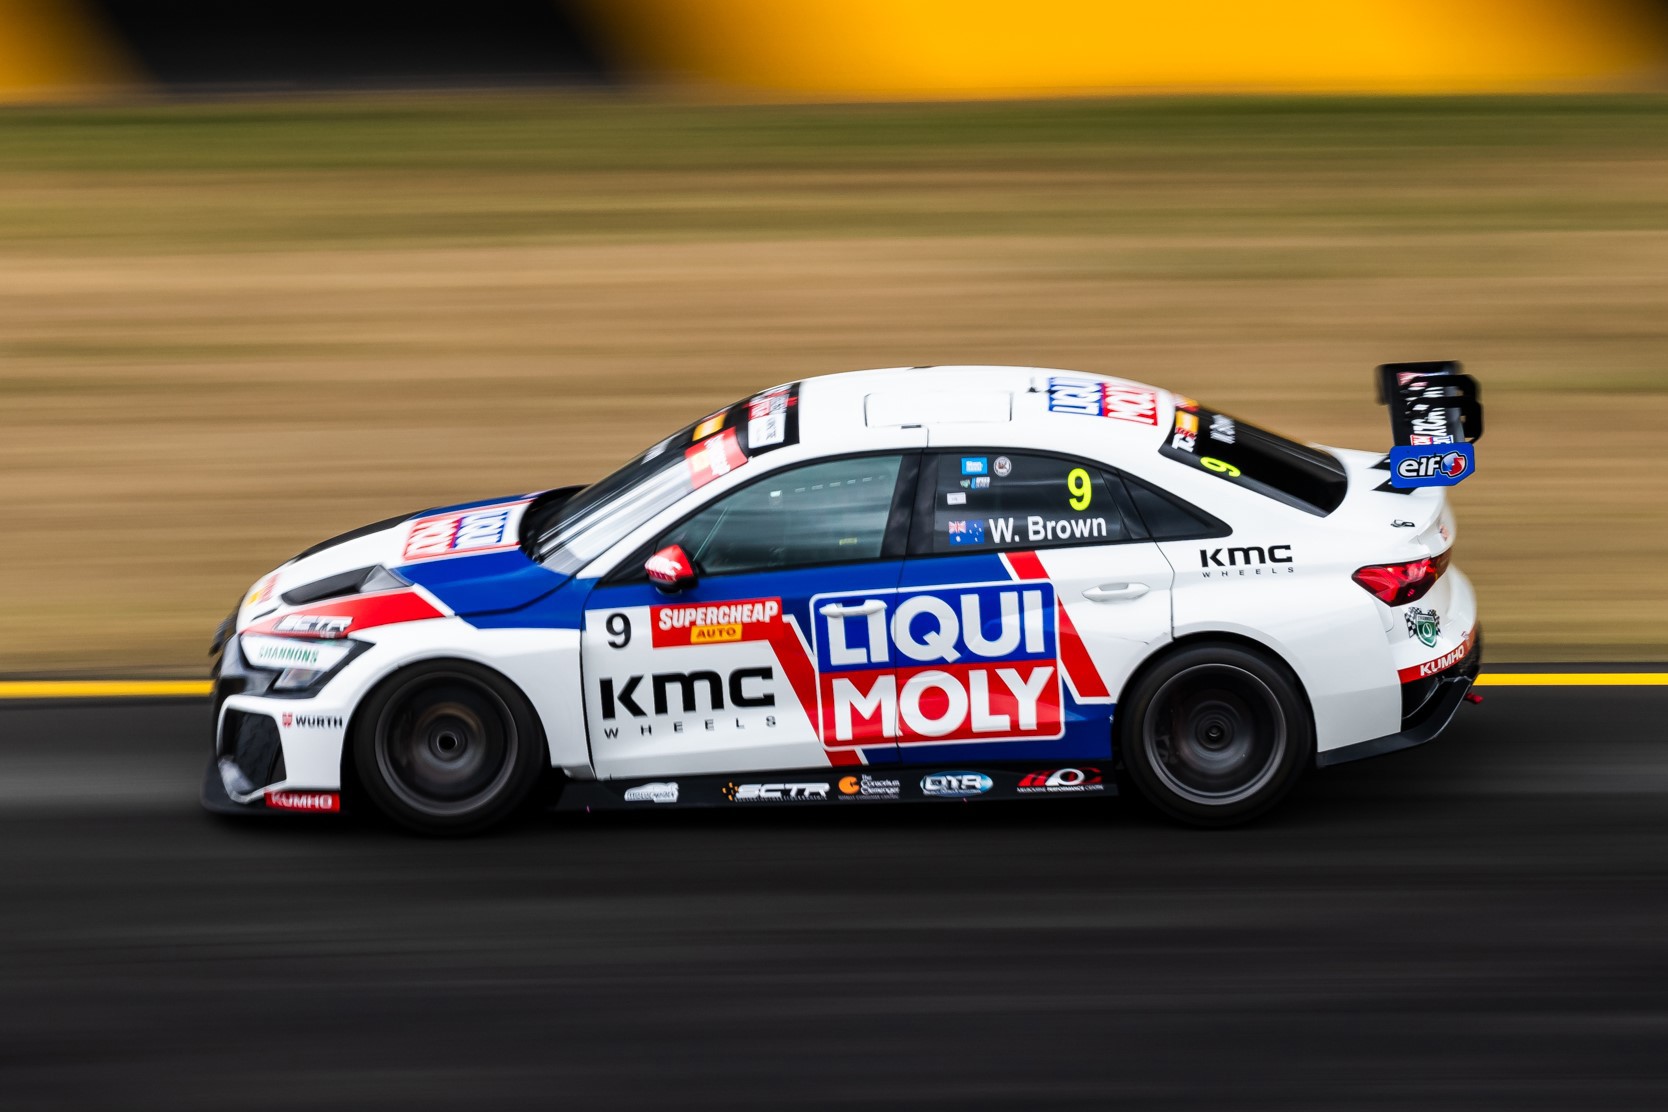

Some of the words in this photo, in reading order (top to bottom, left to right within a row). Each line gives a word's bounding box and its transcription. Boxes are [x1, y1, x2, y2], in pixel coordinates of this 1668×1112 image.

[1200, 456, 1241, 477] 9
[1398, 455, 1442, 477] elf
[1067, 468, 1092, 511] 9
[988, 517, 1020, 544] W.
[1027, 515, 1107, 541] Brown
[1202, 566, 1294, 578] WHEELS
[658, 600, 779, 630] SUPERCHEAP
[825, 590, 1046, 667] LIQUI
[605, 612, 632, 649] 9
[695, 626, 737, 639] AUTO
[1419, 645, 1465, 677] KUMHO
[831, 666, 1055, 742] MOLY
[604, 715, 777, 739] WHEELS
[271, 793, 333, 809] KUMHO
